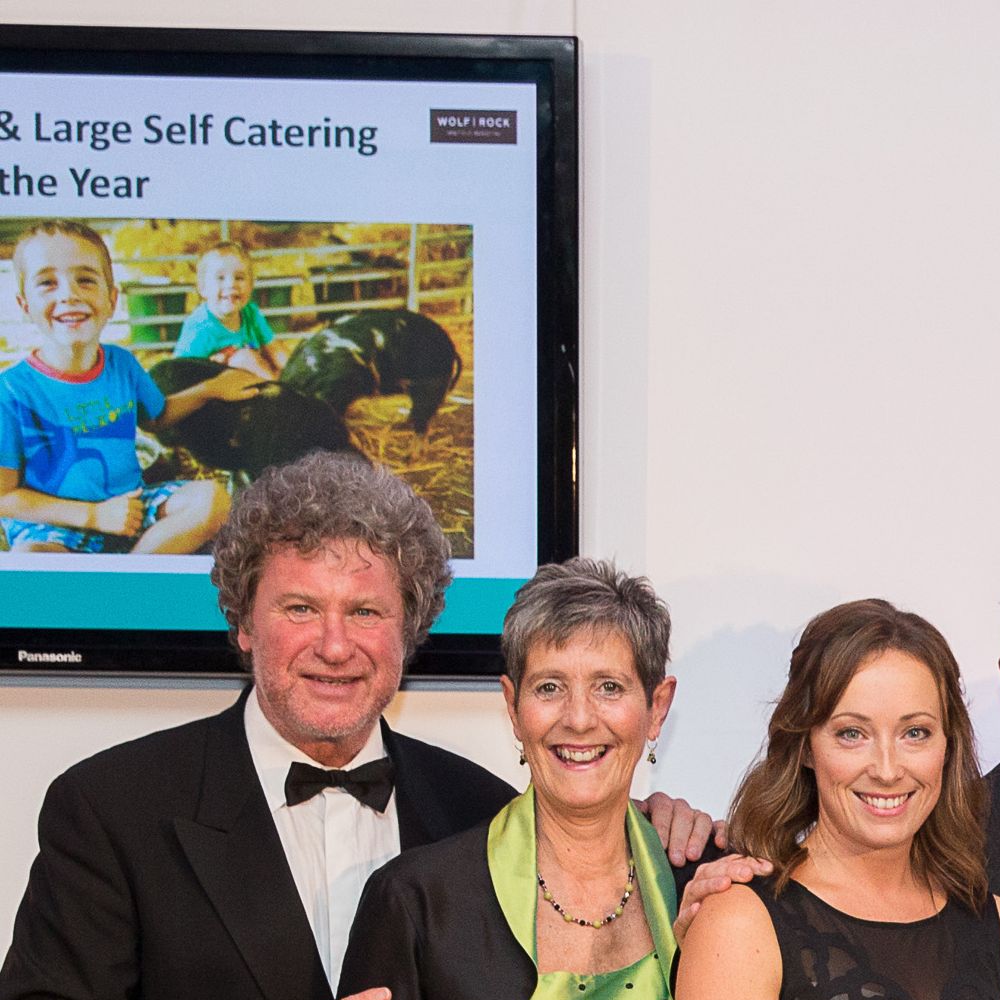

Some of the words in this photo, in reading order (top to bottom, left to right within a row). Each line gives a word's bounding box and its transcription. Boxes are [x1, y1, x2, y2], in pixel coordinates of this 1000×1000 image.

[0, 110, 21, 141] &
[34, 111, 133, 151] Large
[143, 113, 214, 145] Self
[223, 115, 379, 156] Catering
[436, 116, 471, 128] WOLF
[478, 117, 511, 129] ROCK
[0, 164, 58, 197] the
[68, 167, 151, 199] Year
[17, 650, 83, 664] Panasonic
